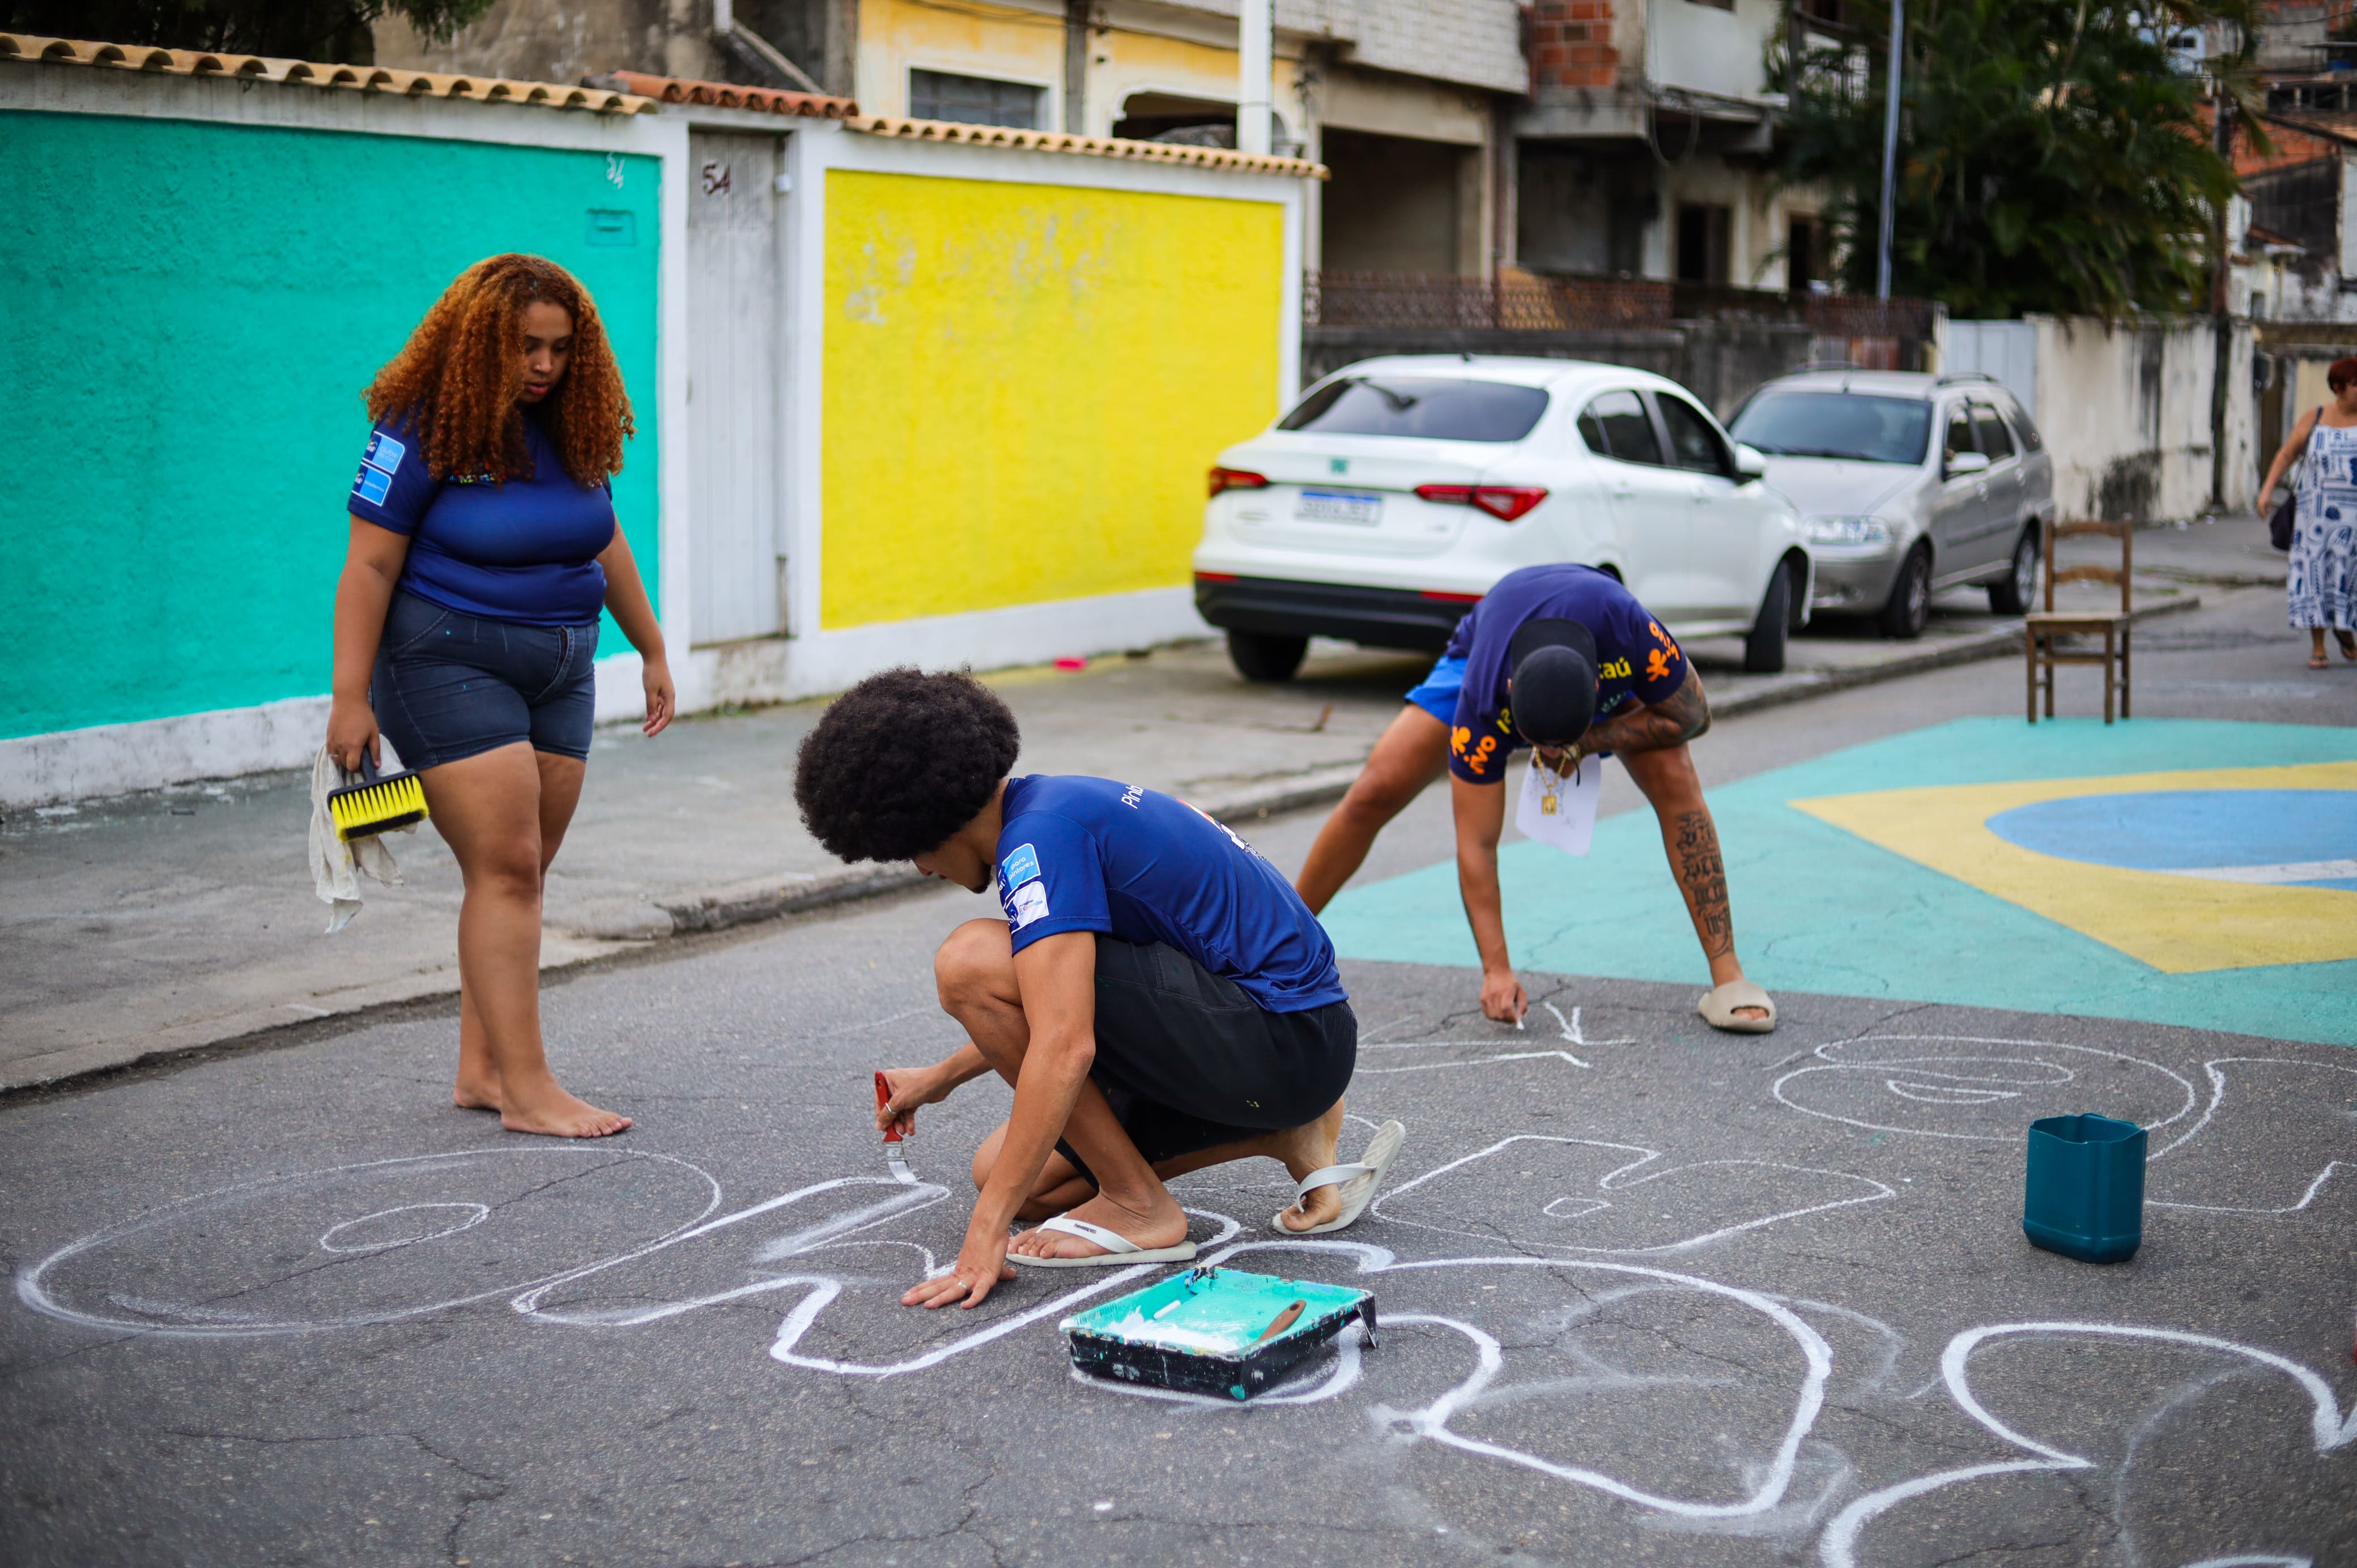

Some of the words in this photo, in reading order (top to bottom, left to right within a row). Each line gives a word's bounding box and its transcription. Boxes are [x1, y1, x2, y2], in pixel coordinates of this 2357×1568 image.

[703, 163, 730, 195] 54
[1009, 860, 1034, 881] pintores
[1011, 856, 1026, 871] para
